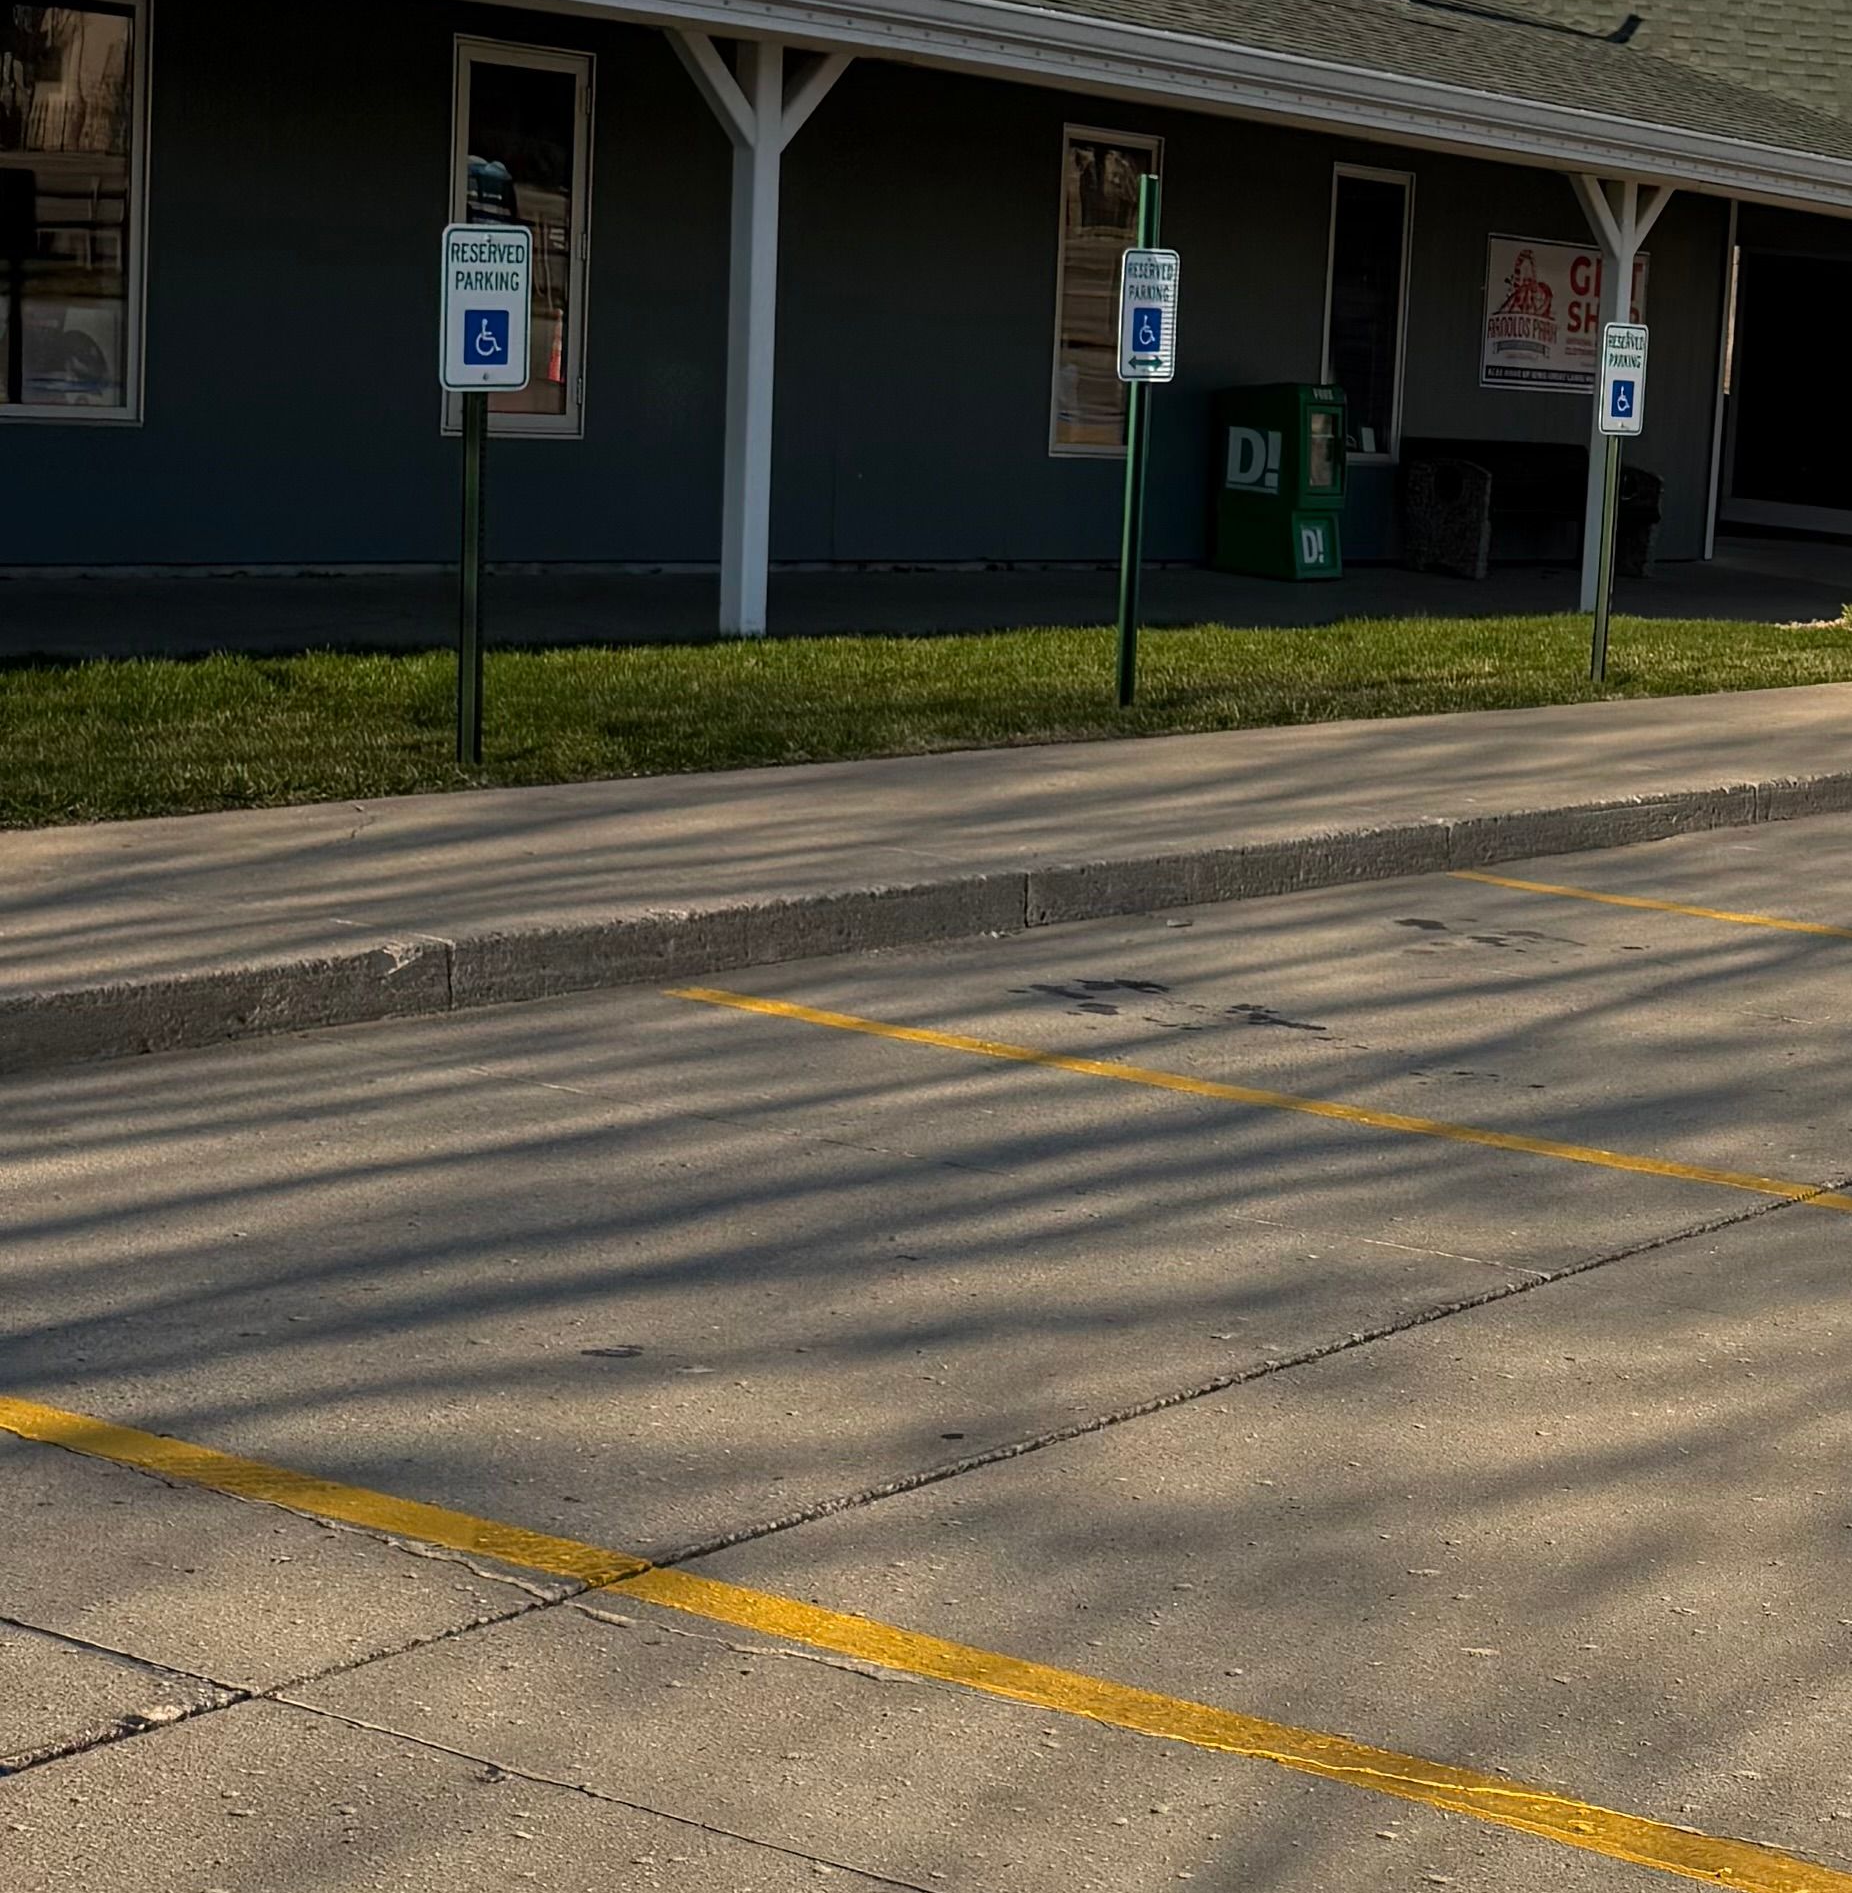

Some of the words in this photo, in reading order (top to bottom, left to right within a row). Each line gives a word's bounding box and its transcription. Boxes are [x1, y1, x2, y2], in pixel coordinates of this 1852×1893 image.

[451, 242, 526, 264] RESERVED
[455, 271, 520, 292] PARKING
[1127, 262, 1174, 281] RESERVED
[1128, 285, 1170, 303] PARKING
